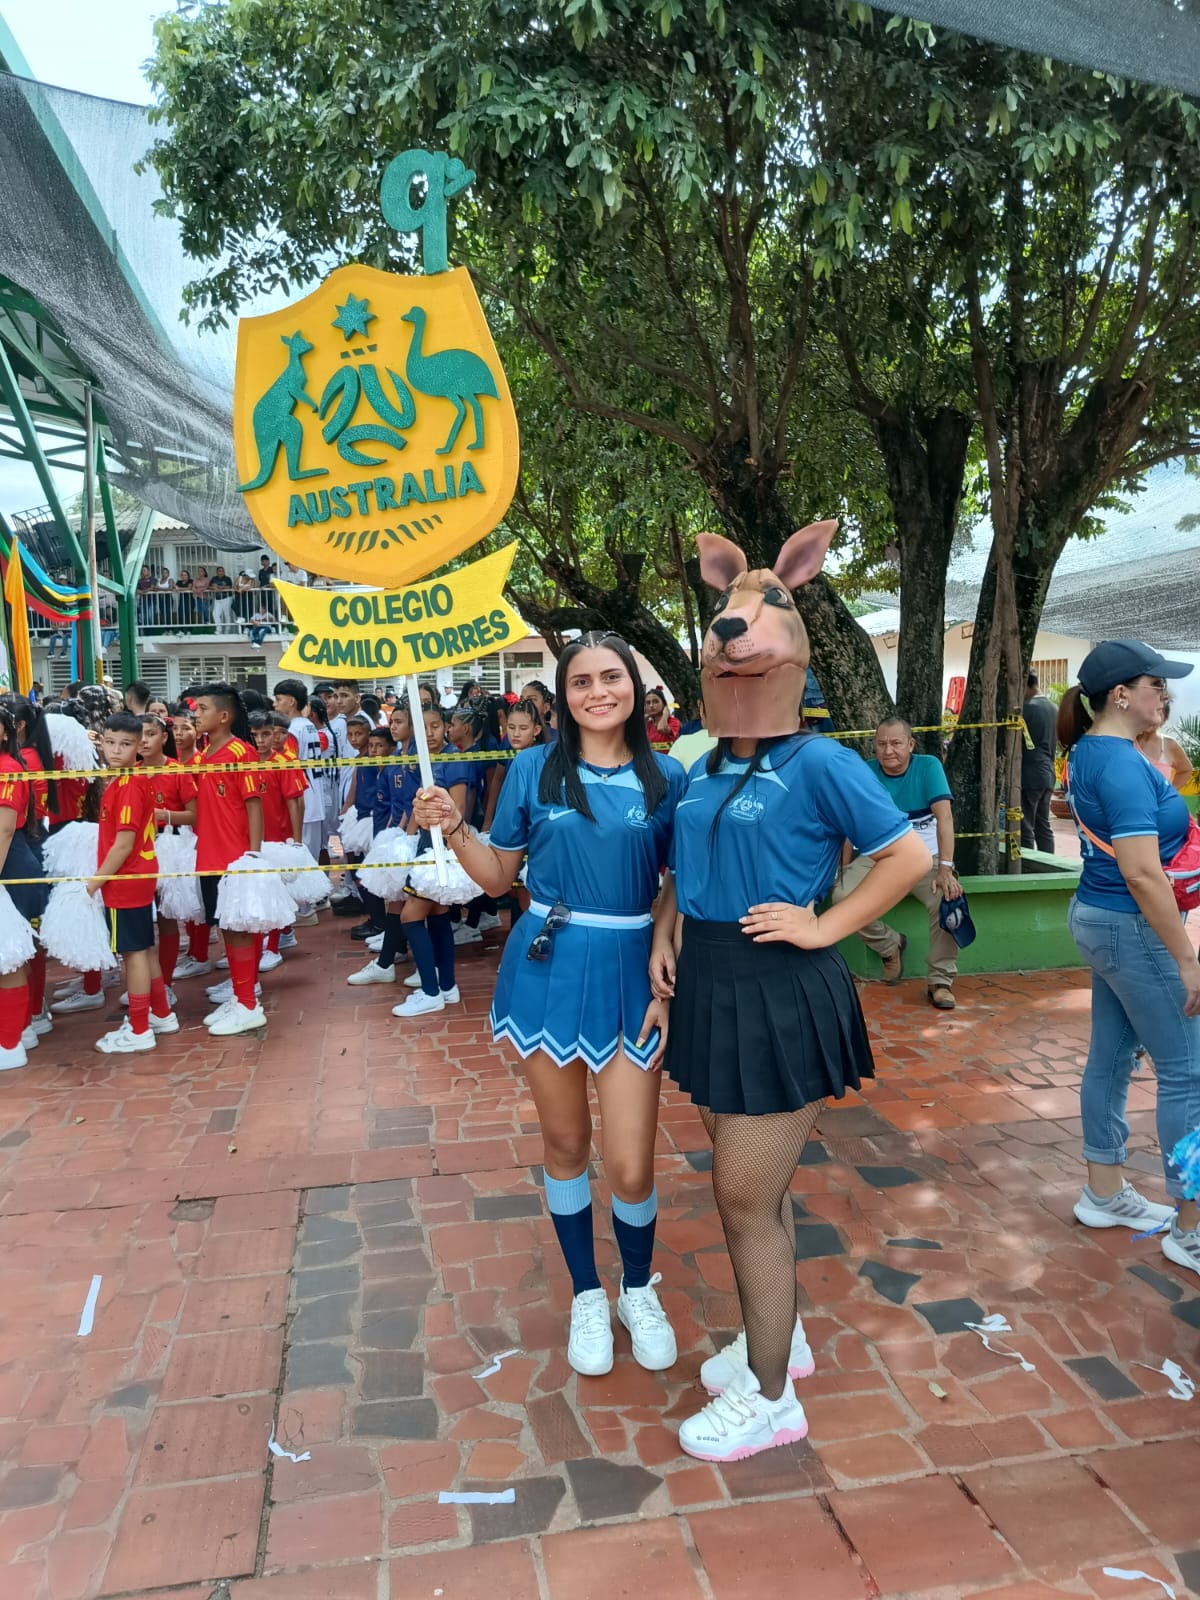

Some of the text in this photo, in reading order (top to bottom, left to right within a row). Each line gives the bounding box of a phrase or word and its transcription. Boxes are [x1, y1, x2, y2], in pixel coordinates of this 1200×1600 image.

[287, 461, 486, 527] AUSTRALIA
[329, 583, 453, 628] COLEGIO
[298, 609, 510, 669] CAMILO TORRES
[394, 774, 403, 789] 15
